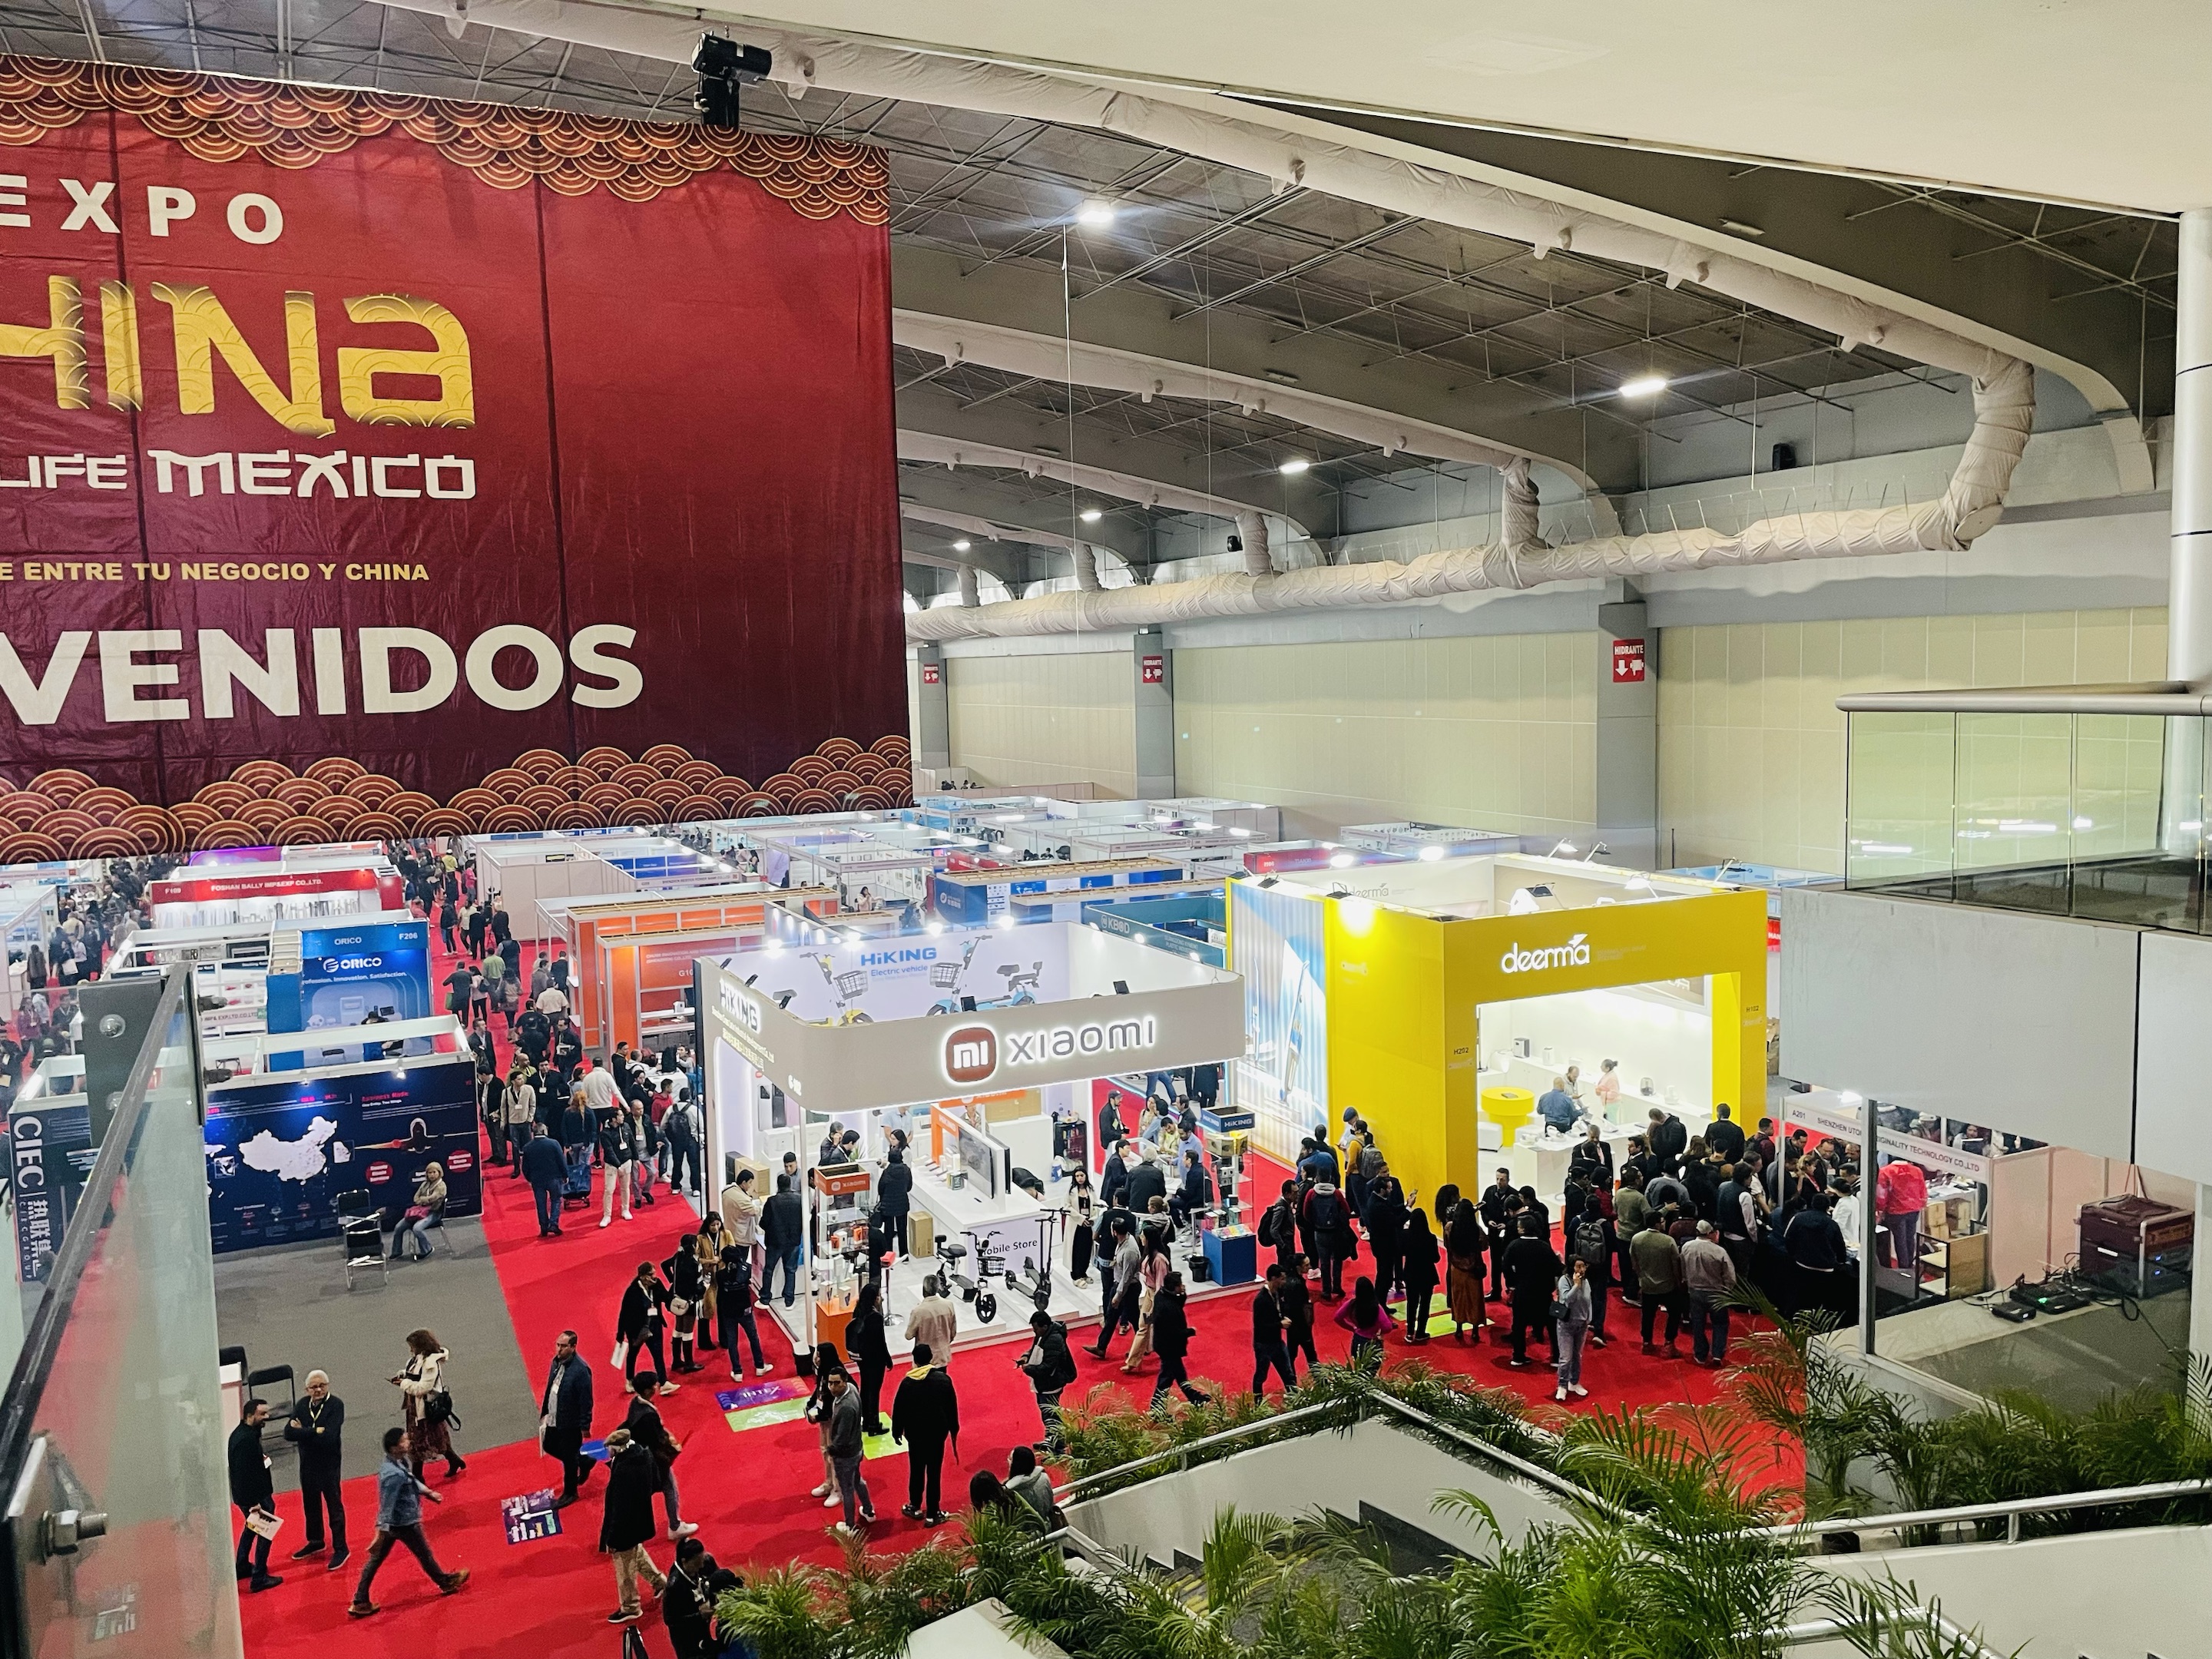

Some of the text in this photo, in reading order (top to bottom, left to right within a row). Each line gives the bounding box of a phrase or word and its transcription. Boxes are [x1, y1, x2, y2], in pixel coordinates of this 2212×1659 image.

[0, 174, 283, 244] EXPO
[147, 449, 476, 499] MEXICO
[24, 562, 123, 581] ENTRE
[132, 563, 171, 581] TU
[181, 563, 310, 581] NEGOCIO
[320, 563, 337, 580] Y
[345, 564, 429, 581] CHINA
[1614, 645, 1644, 655] HIDRANTE
[0, 624, 644, 725] VENIDOS
[334, 936, 362, 945] ORICO
[340, 957, 382, 969] ORICO
[861, 948, 937, 966] HiKING
[1502, 935, 1591, 973] deerma
[871, 965, 928, 977] Electric vehicle
[1008, 1020, 1154, 1063] xiaomi
[1224, 1118, 1252, 1128] HiKING
[1817, 1117, 1846, 1132] SHENZHEN
[1909, 1145, 1953, 1164] TECHNOLOGY
[14, 1116, 45, 1189] CIEC
[1013, 1240, 1038, 1250] Store
